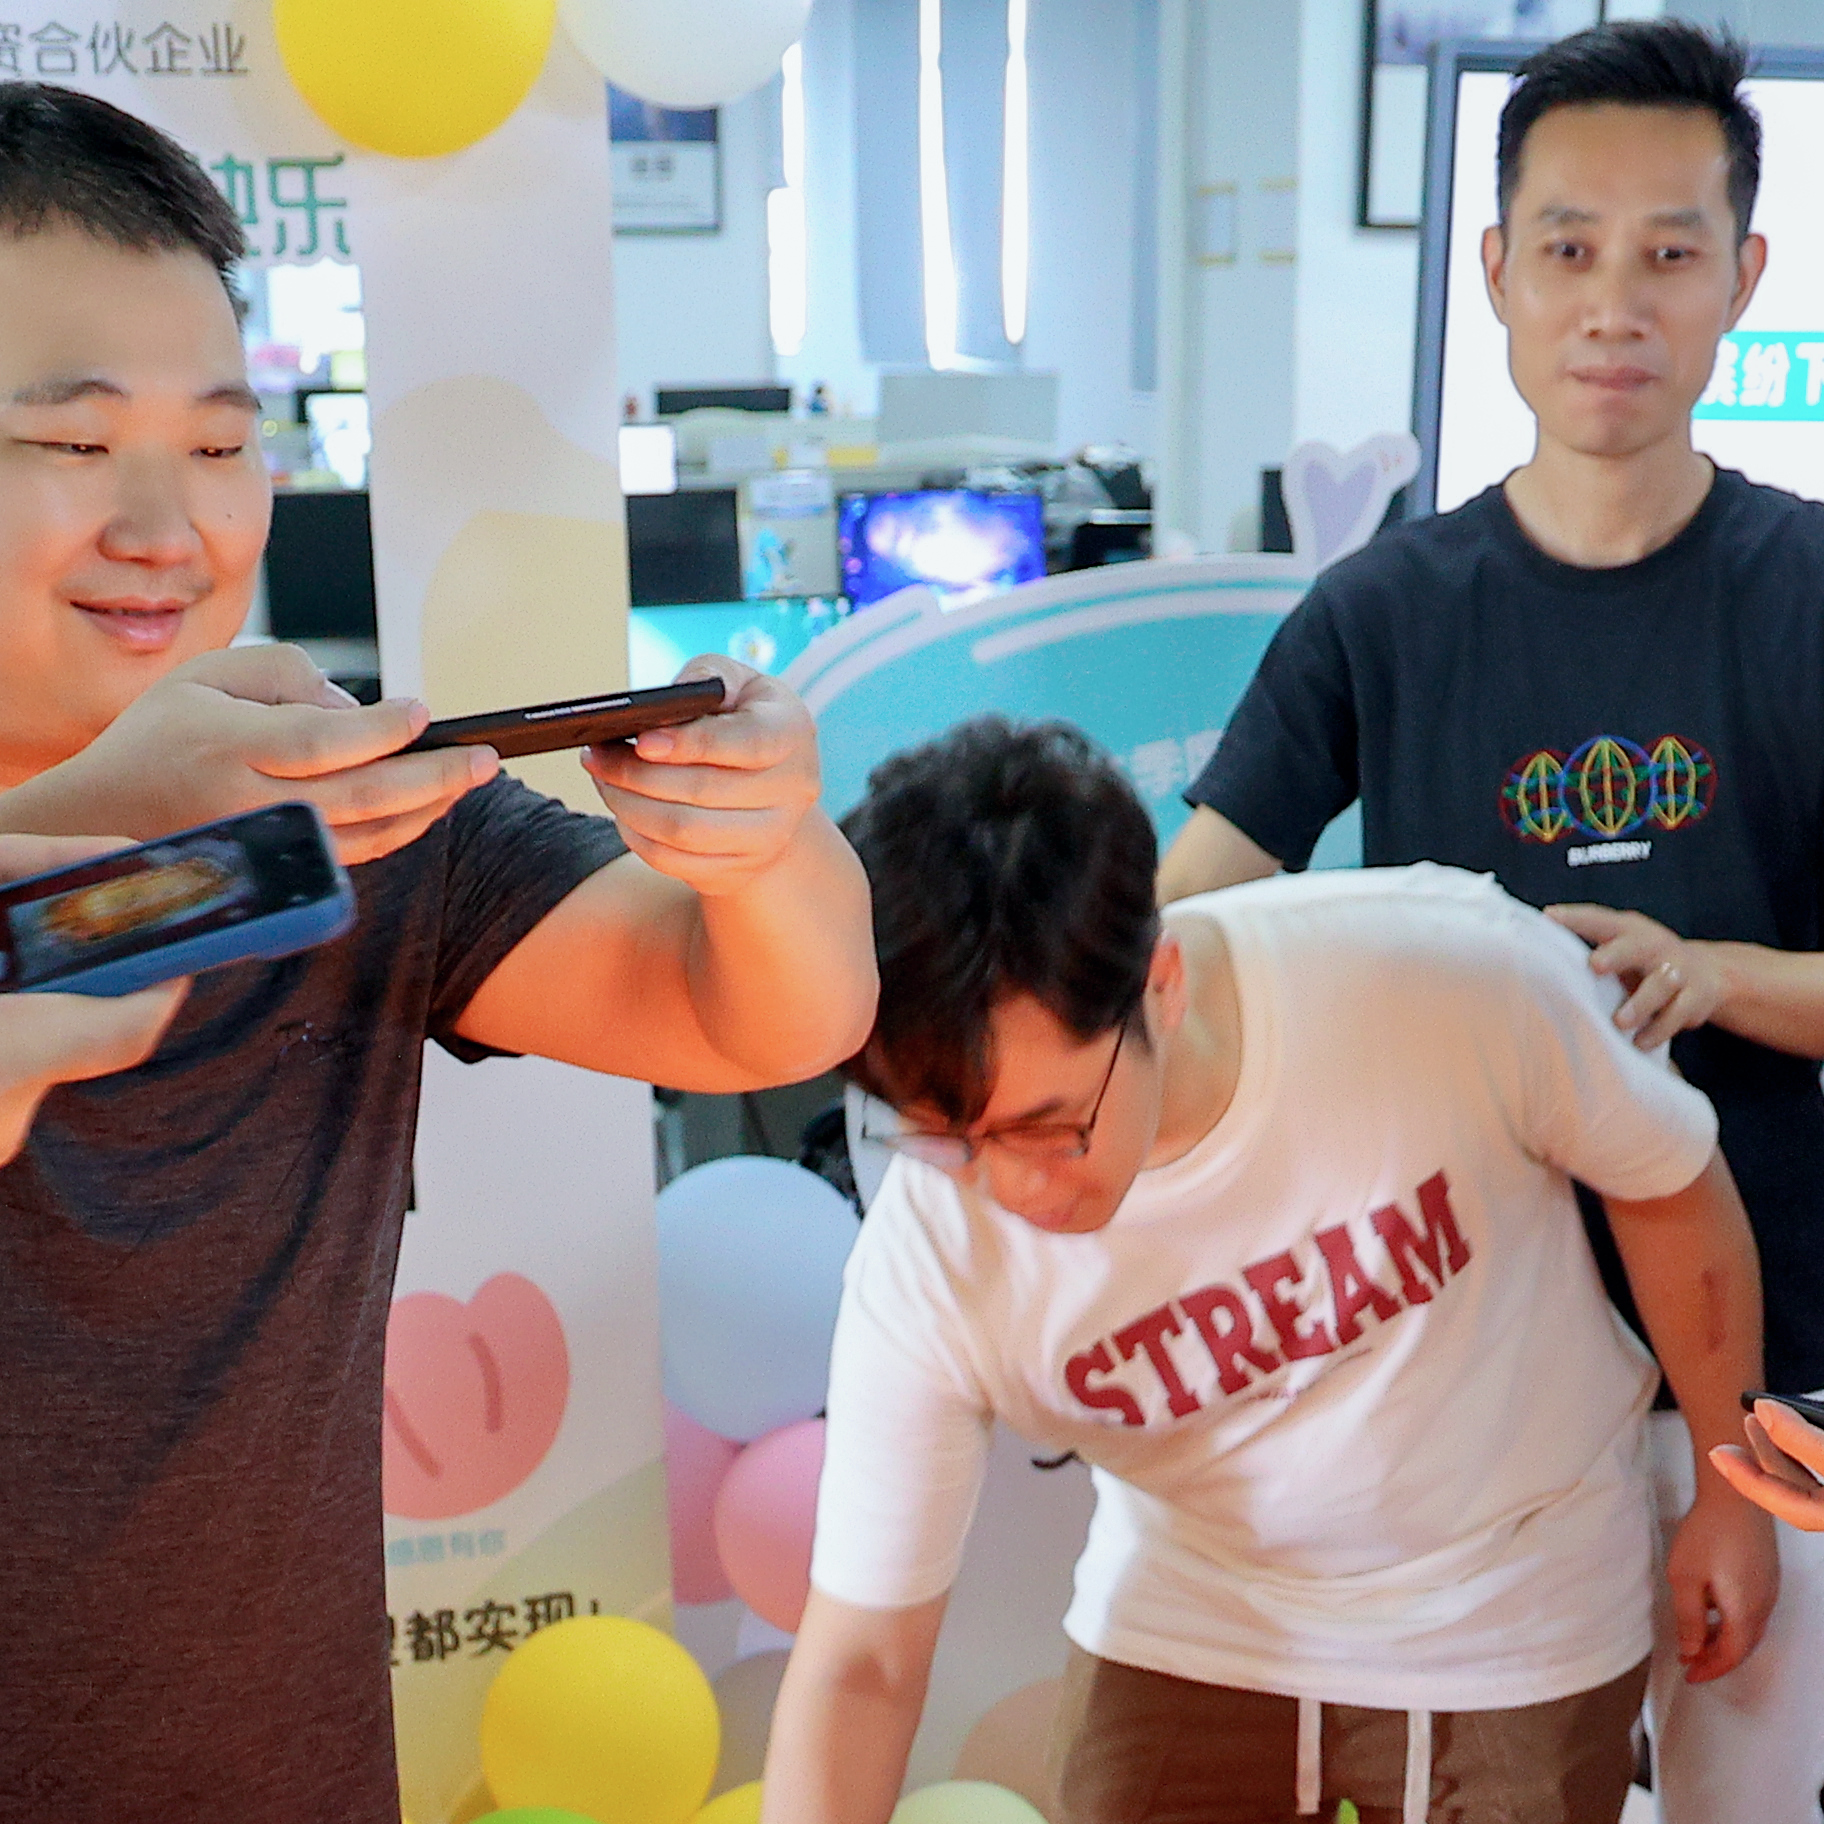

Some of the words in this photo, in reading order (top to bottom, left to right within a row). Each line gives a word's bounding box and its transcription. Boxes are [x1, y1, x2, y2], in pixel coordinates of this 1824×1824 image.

[1064, 1168, 1471, 1427] STREAM
[388, 1592, 599, 1666] 都实现
